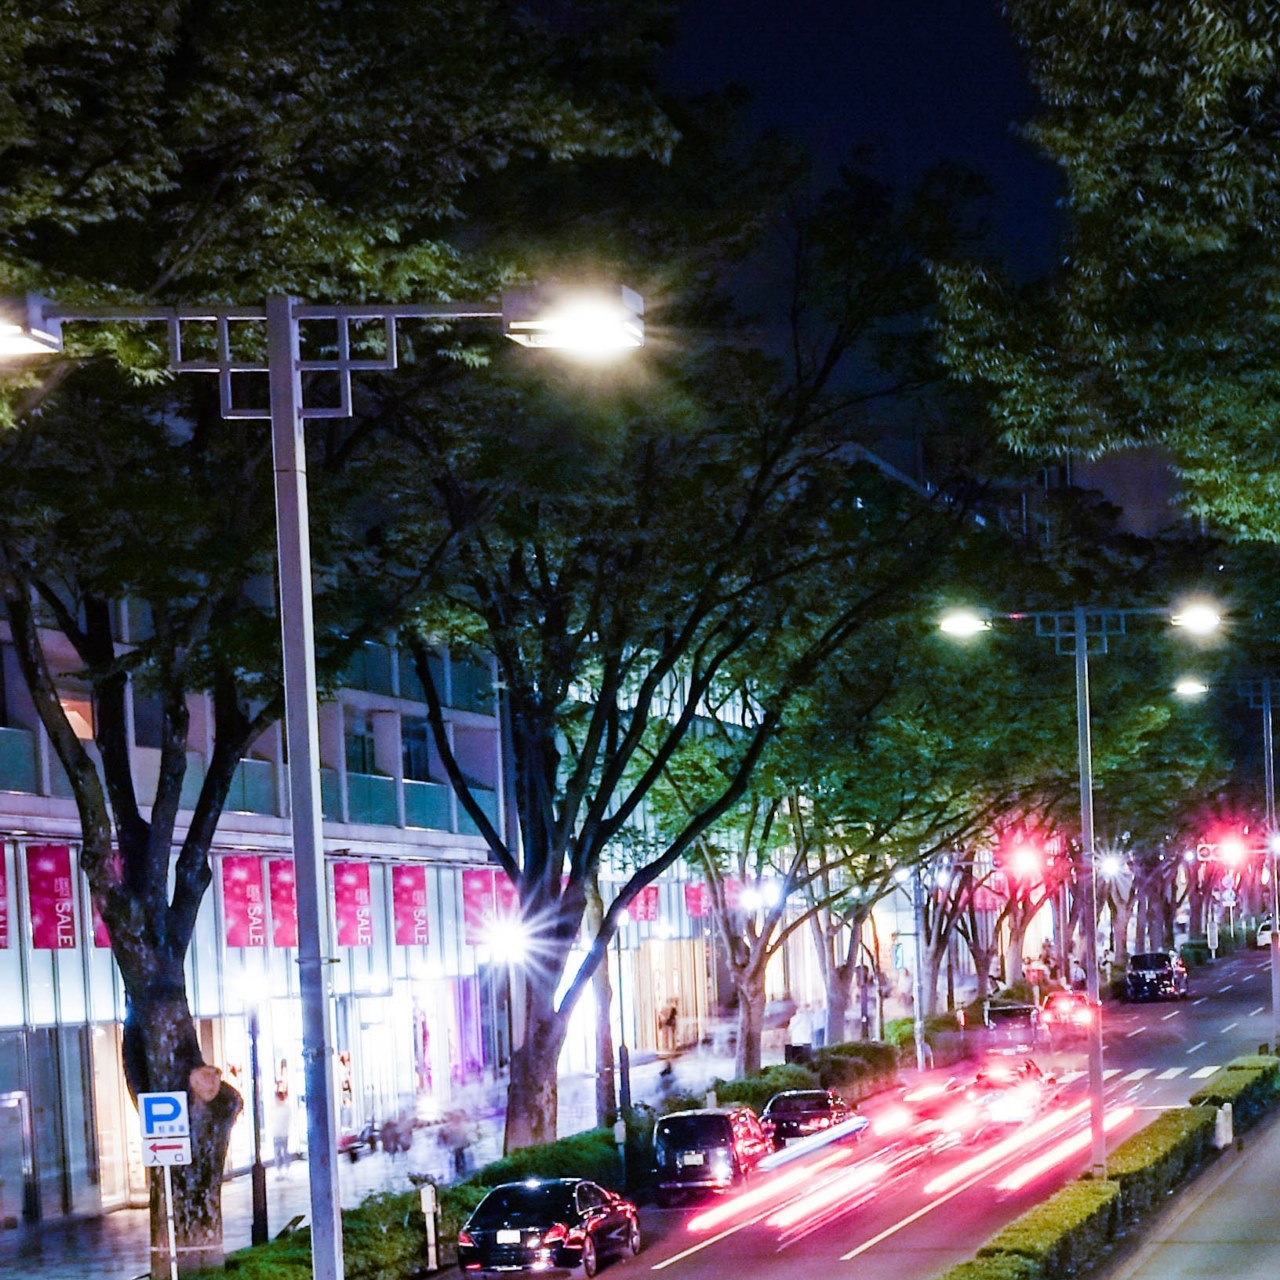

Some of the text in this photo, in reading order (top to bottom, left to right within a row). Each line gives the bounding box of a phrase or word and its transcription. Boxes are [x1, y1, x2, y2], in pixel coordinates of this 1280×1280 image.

[55, 901, 74, 947] SALE
[247, 905, 264, 946] SALE
[356, 907, 372, 945] SALE
[413, 908, 427, 944] SALE
[144, 1096, 182, 1134] P
